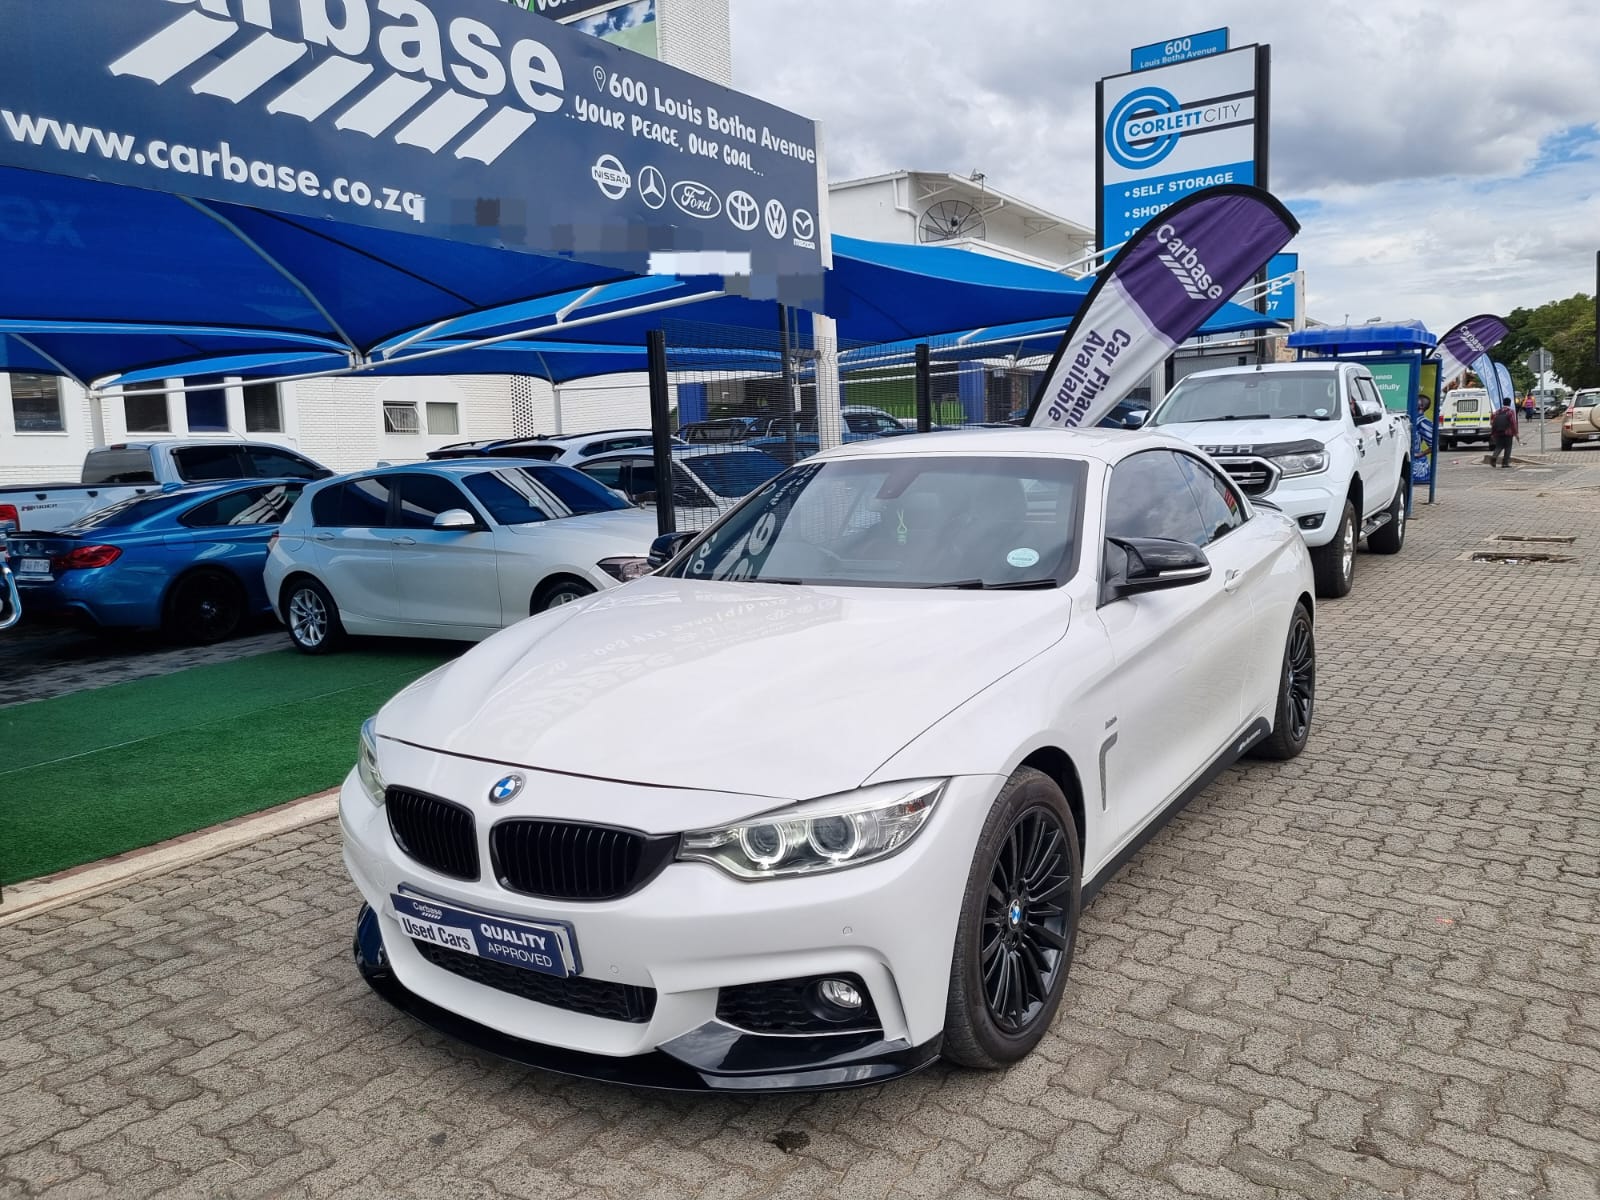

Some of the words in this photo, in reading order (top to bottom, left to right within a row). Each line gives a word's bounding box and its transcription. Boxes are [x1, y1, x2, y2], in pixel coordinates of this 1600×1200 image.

[1140, 58, 1160, 69] Louis
[1162, 53, 1185, 64] Botha
[1186, 47, 1217, 58] Avenue
[1165, 38, 1191, 55] 600
[609, 72, 648, 107] 600
[654, 87, 703, 126] Louis
[707, 106, 757, 144] Botha
[761, 127, 816, 164] Avenue
[631, 114, 685, 153] PEACE,
[689, 132, 719, 160] OUR
[594, 168, 629, 186] NISSAN
[1132, 184, 1165, 198] SELF
[1168, 171, 1234, 193] STORAGE
[681, 185, 712, 212] Ford
[1132, 202, 1174, 218] SHOP
[1156, 224, 1223, 300] Carbase
[1101, 328, 1132, 367] Car
[1047, 330, 1106, 421] Available
[1201, 444, 1253, 454] GER
[402, 917, 436, 941] Used
[439, 929, 471, 951] Cars
[480, 923, 546, 950] QUALITY
[488, 942, 553, 968] APPROVED
